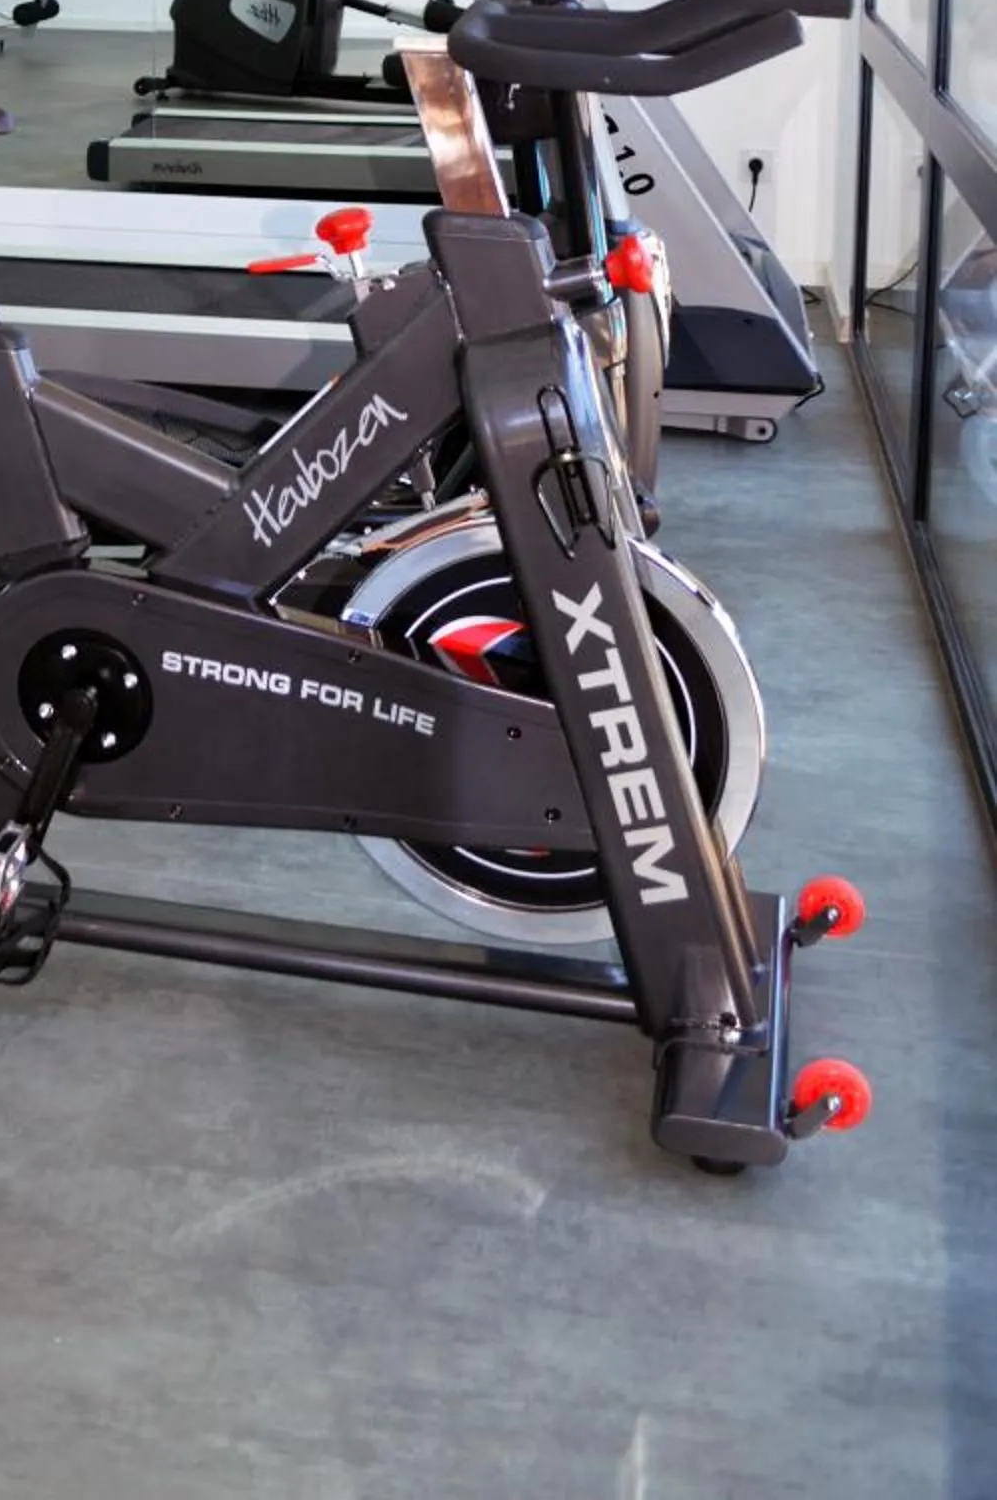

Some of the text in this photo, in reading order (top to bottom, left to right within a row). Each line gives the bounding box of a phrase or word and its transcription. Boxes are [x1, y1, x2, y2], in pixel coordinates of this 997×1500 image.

[161, 650, 436, 737] STRONG FOR LIFE
[551, 581, 689, 905] XTREM
